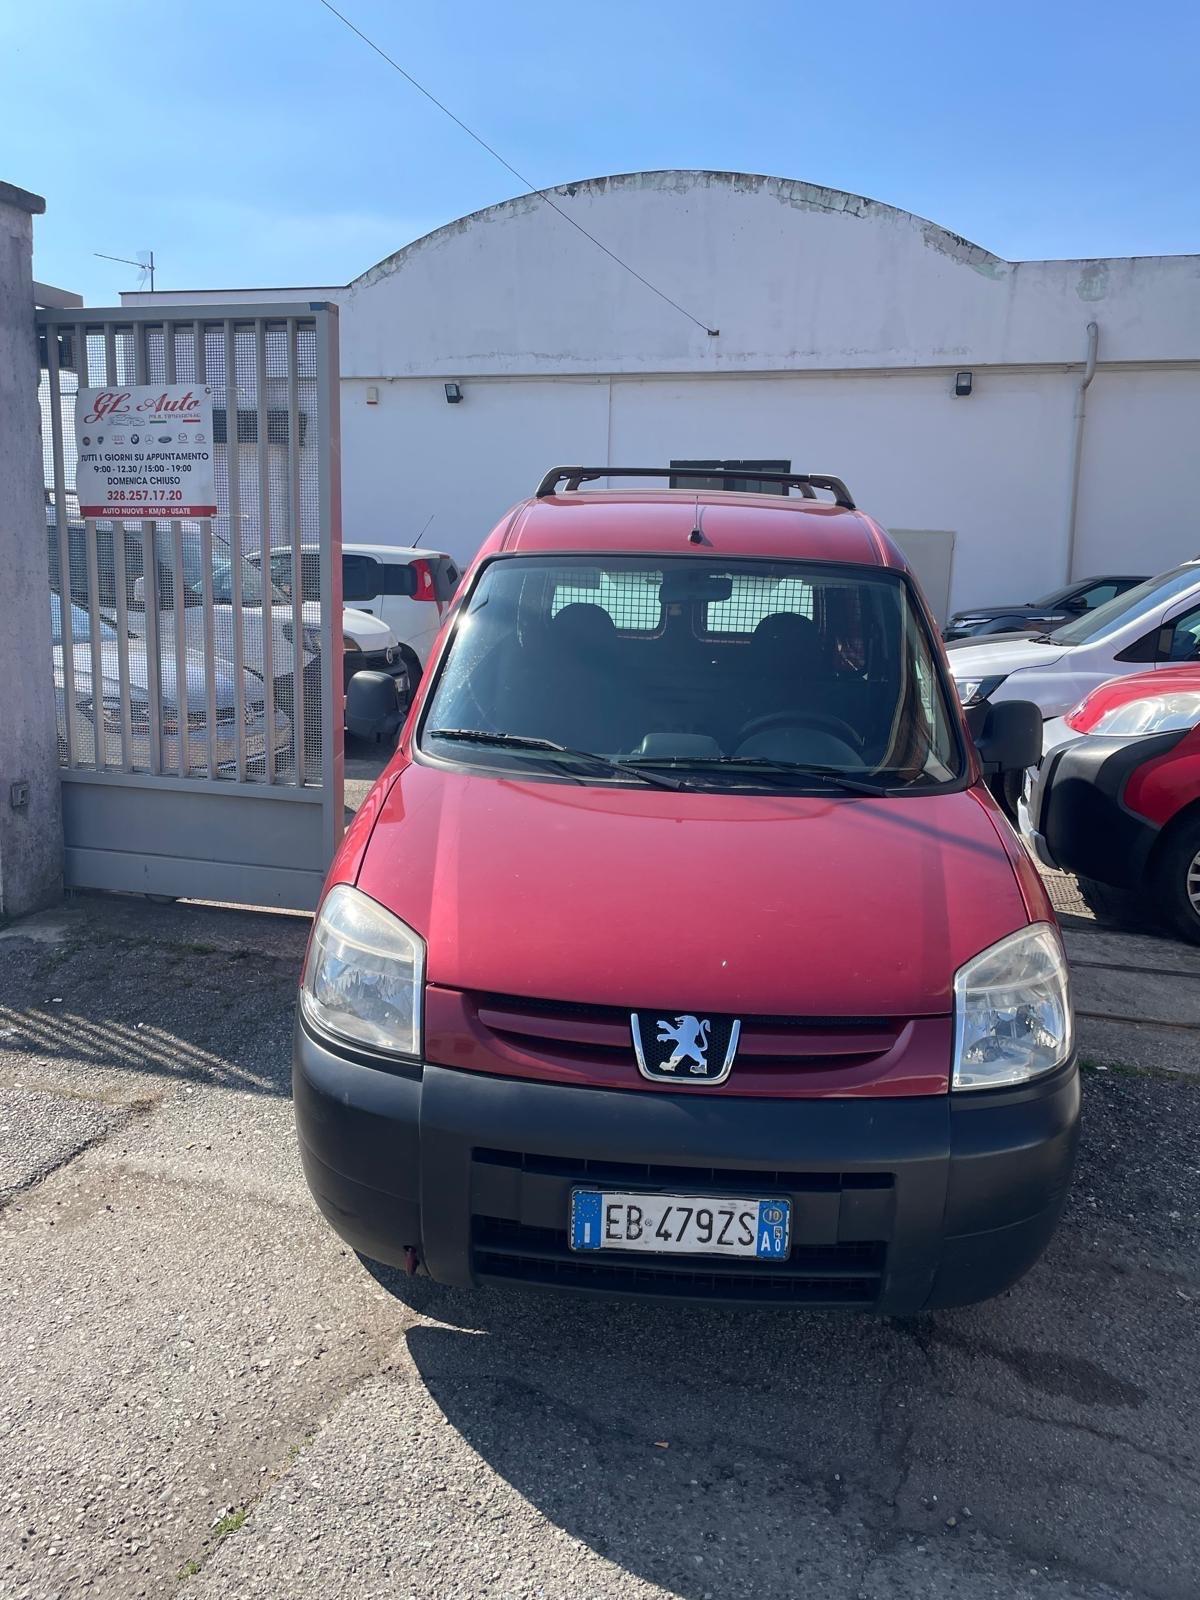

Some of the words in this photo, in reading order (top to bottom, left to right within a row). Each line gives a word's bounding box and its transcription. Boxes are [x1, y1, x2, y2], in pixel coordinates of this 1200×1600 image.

[136, 390, 200, 413] Auto
[80, 453, 97, 462] TUTTI
[104, 453, 133, 462] GIORNI
[134, 453, 144, 461] SU
[146, 452, 209, 461] APPUNTAMENTO
[93, 465, 111, 473] 9:00
[117, 465, 137, 473] 12.30
[144, 464, 164, 473] 15:00
[171, 464, 192, 472] 19:00
[107, 477, 148, 485] DOMENICA
[150, 476, 181, 485] CHIUSO
[107, 490, 182, 501] 328.257.17.20
[121, 507, 144, 515] NUOVE
[170, 507, 191, 515] USATE
[605, 1204, 643, 1241] EB
[655, 1206, 756, 1246] 479ZS
